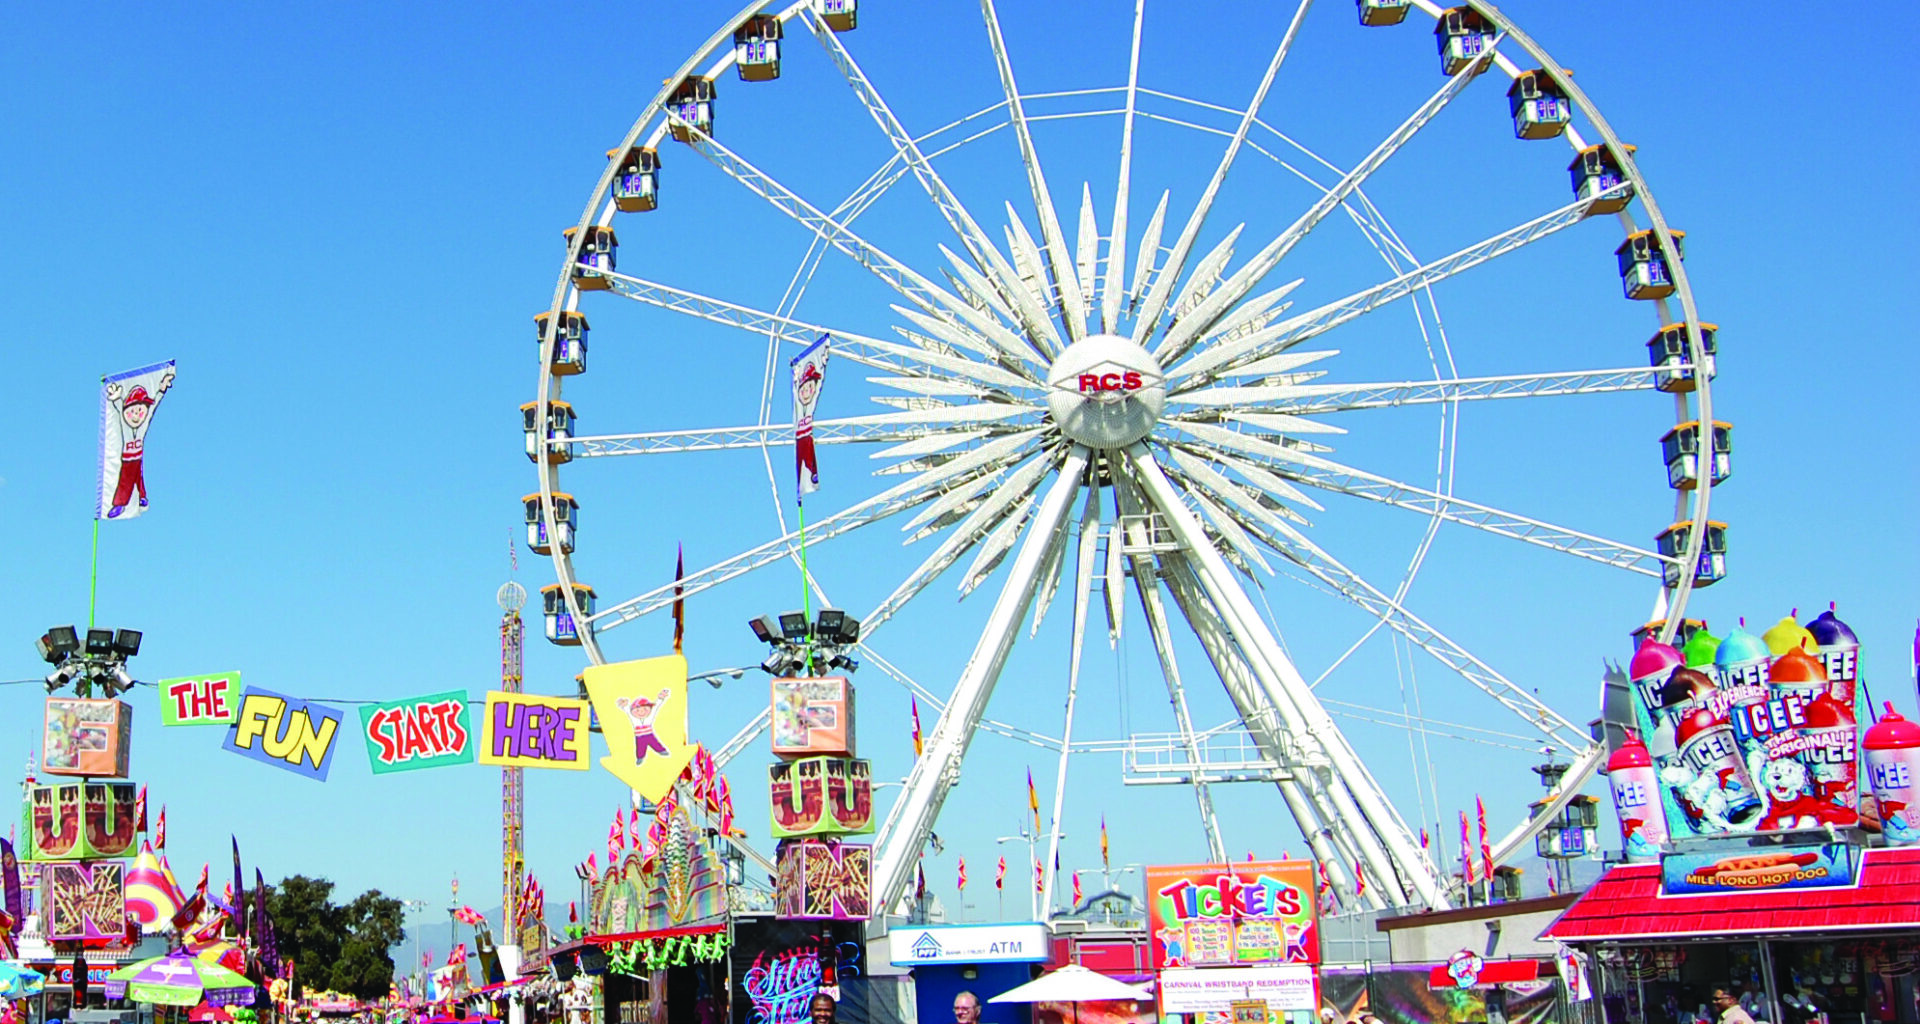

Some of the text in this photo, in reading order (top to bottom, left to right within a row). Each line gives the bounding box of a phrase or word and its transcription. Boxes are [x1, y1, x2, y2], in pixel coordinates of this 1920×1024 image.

[1079, 372, 1142, 392] RCS
[1708, 685, 1766, 720] EXPERIENCE
[169, 680, 581, 772] THE FUN STARTS HERE
[1735, 698, 1805, 738] ICEE
[1686, 733, 1735, 769] ICEE
[1765, 728, 1796, 748] THE
[1685, 867, 1828, 886] MILE LONG HOT DOG
[1159, 876, 1302, 919] TICKETS
[989, 941, 1022, 955] ATM
[1163, 978, 1311, 989] CARNIVAL WRISTBAND REDEMPTION
